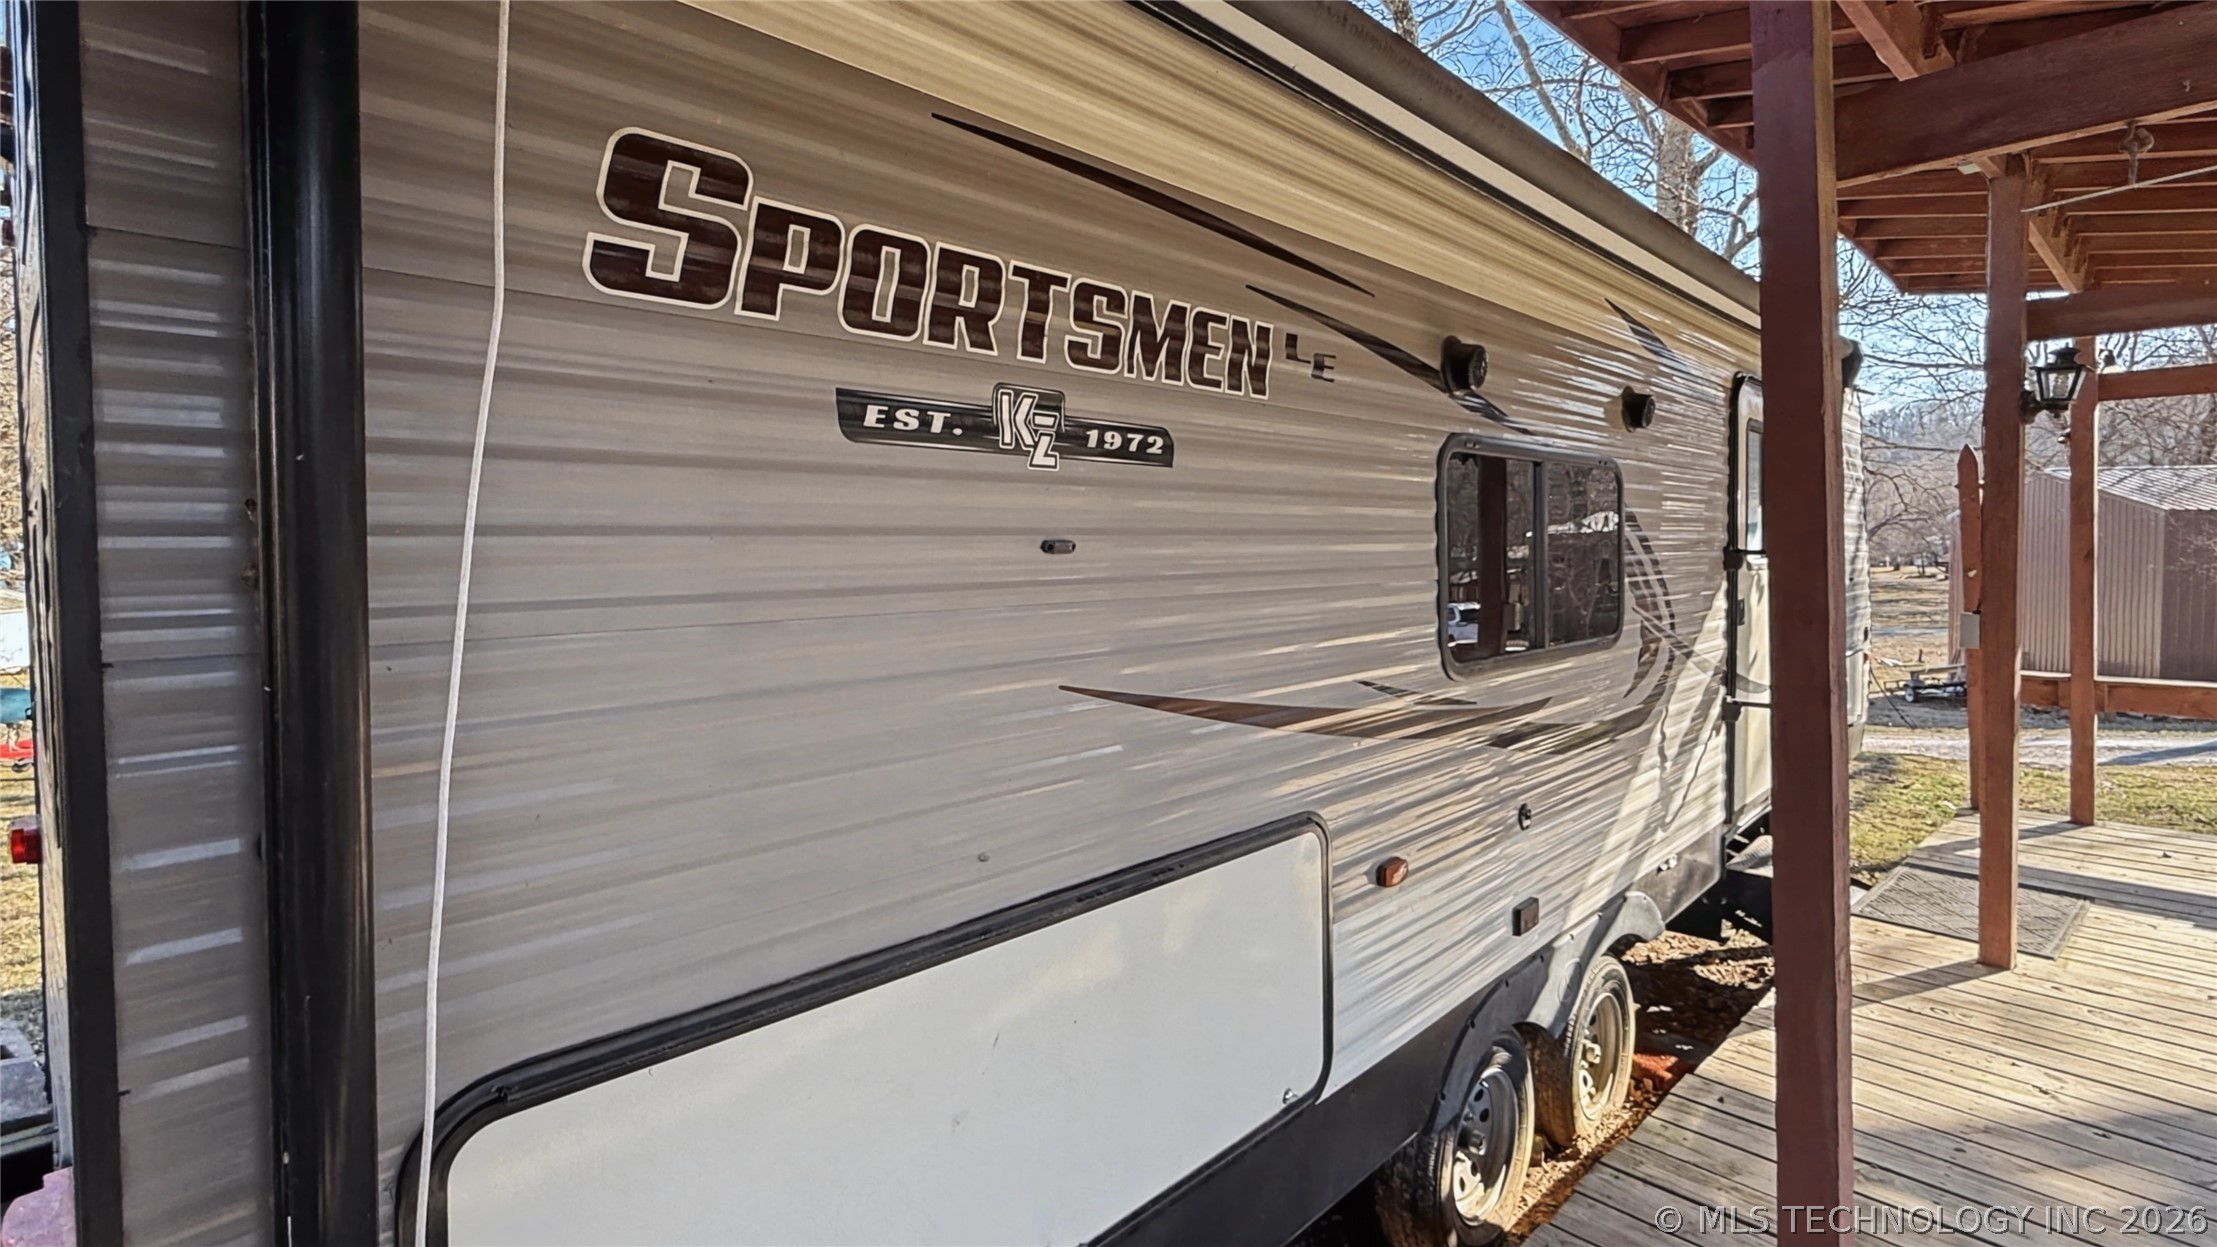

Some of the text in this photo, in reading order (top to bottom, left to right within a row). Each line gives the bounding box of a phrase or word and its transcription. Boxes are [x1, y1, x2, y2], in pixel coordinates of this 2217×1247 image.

[583, 126, 1337, 399] SPORTSMEN LE
[863, 404, 963, 436] EST.
[1085, 428, 1164, 455] 1972
